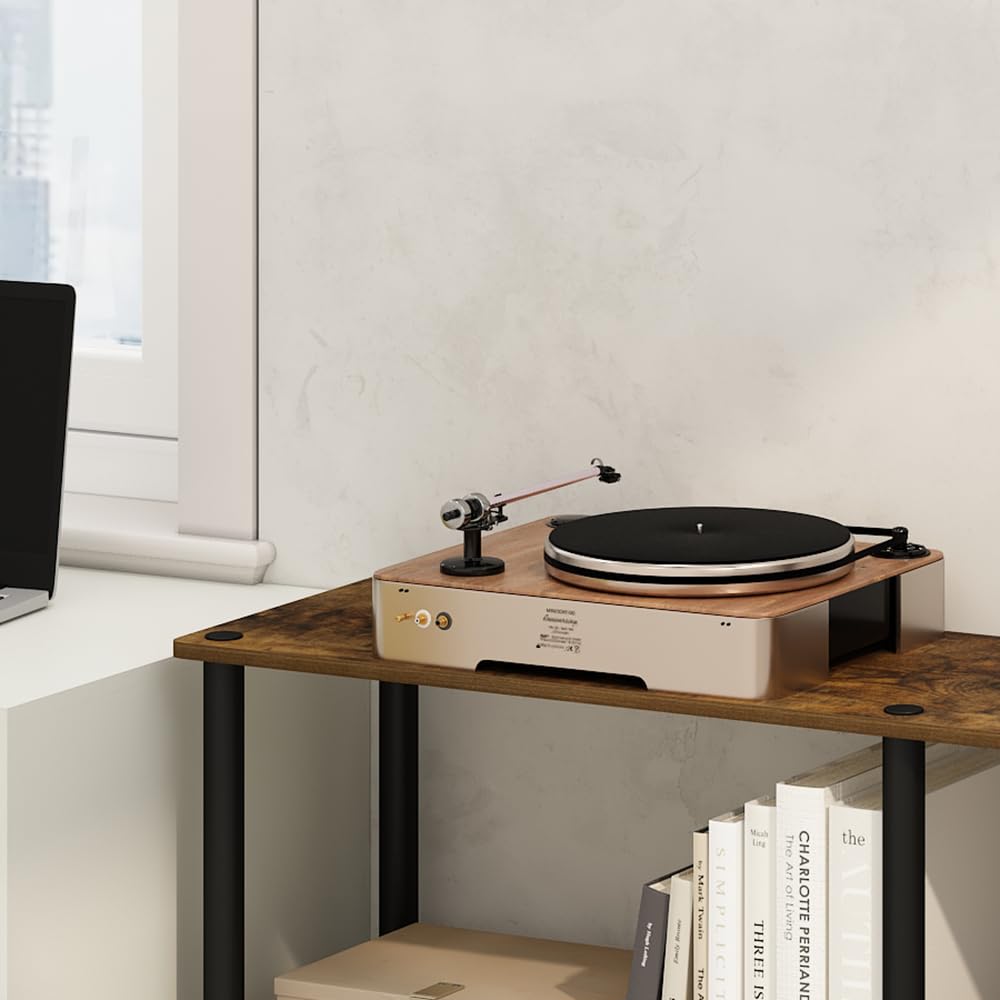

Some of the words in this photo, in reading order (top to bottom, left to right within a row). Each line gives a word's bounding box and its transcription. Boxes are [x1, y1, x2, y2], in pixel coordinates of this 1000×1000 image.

[785, 834, 794, 858] The
[842, 829, 866, 846] the
[785, 862, 794, 881] Art
[799, 830, 810, 921] CHARLOTTE
[785, 884, 794, 902] of
[784, 903, 794, 941] Living
[754, 920, 765, 978] THREE
